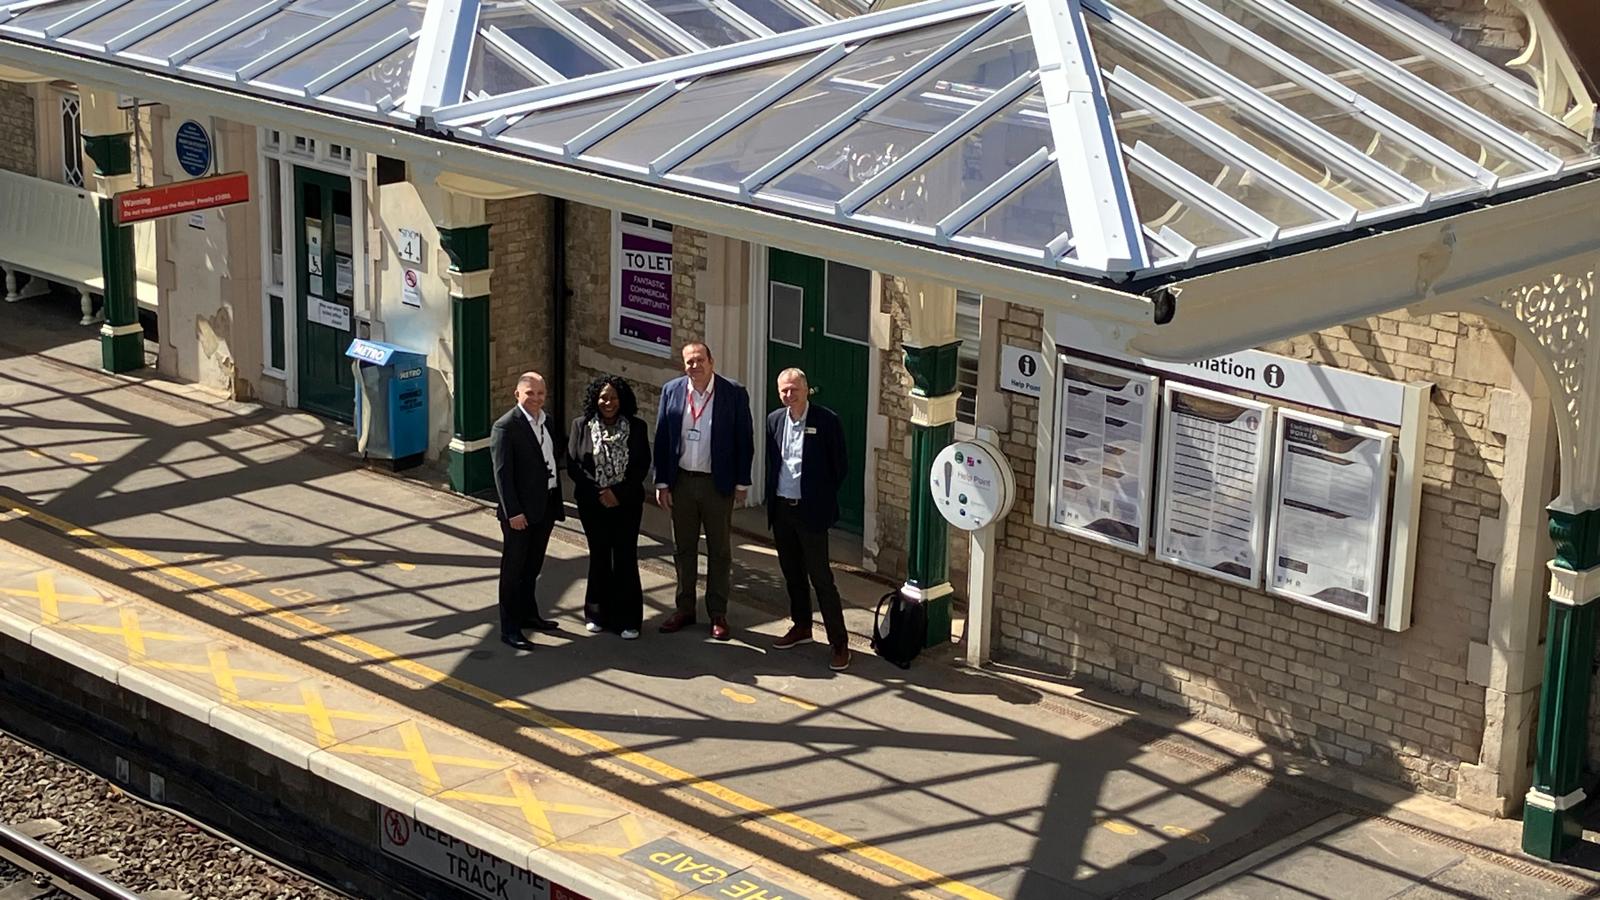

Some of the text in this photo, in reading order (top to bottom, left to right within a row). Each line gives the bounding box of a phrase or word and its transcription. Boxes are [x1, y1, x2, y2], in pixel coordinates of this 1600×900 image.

[122, 197, 151, 208] Warning
[404, 240, 414, 260] 4
[625, 252, 673, 272] TO LET
[633, 274, 665, 290] FANTASTIC
[629, 284, 669, 301] COMMERCIAL
[628, 294, 670, 311] OPPORTUNITY
[353, 343, 386, 361] METRO
[399, 369, 422, 380] METRO
[1011, 379, 1025, 390] Help
[973, 474, 991, 488] Point
[446, 851, 510, 900] TRACK
[648, 851, 784, 900] HE GAP
